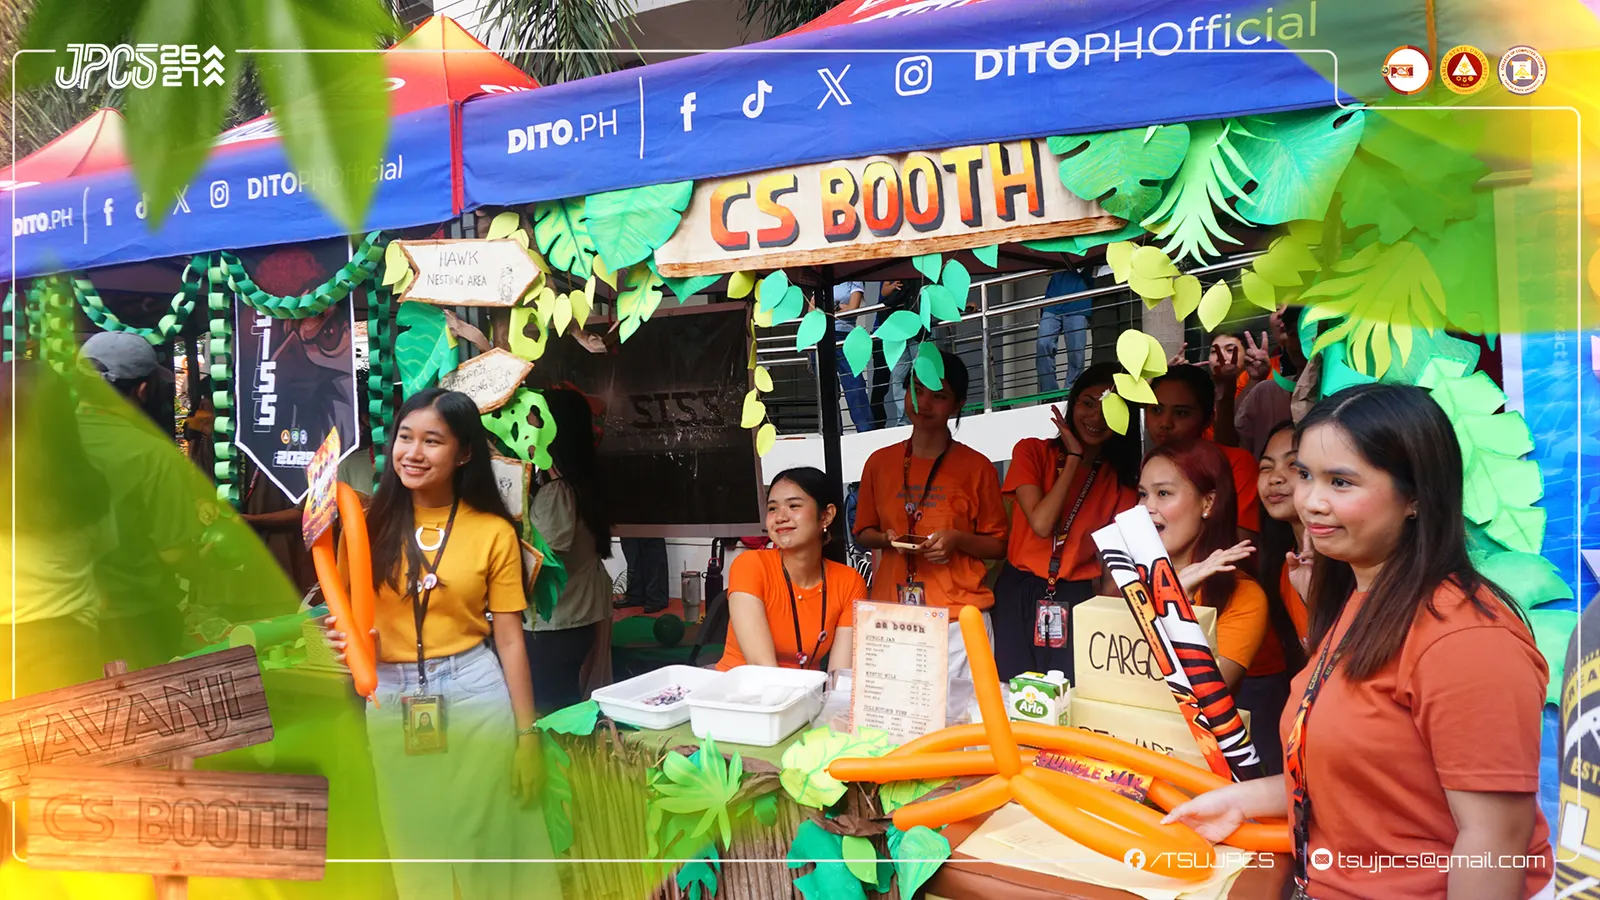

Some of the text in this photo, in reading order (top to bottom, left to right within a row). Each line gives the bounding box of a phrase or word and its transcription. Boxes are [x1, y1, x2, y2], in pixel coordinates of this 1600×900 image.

[975, 1, 1316, 81] DITOPHOfficial
[507, 109, 617, 154] DITO.PH
[710, 139, 1045, 251] CS BOOTH
[14, 207, 74, 237] DITO.PH
[439, 250, 479, 268] HAWK
[427, 273, 487, 287] NESTING AREA
[1079, 469, 1098, 498] UNIVERSITY
[893, 621, 926, 634] booth
[1019, 701, 1044, 715] Arla
[1103, 768, 1145, 791] JAR
